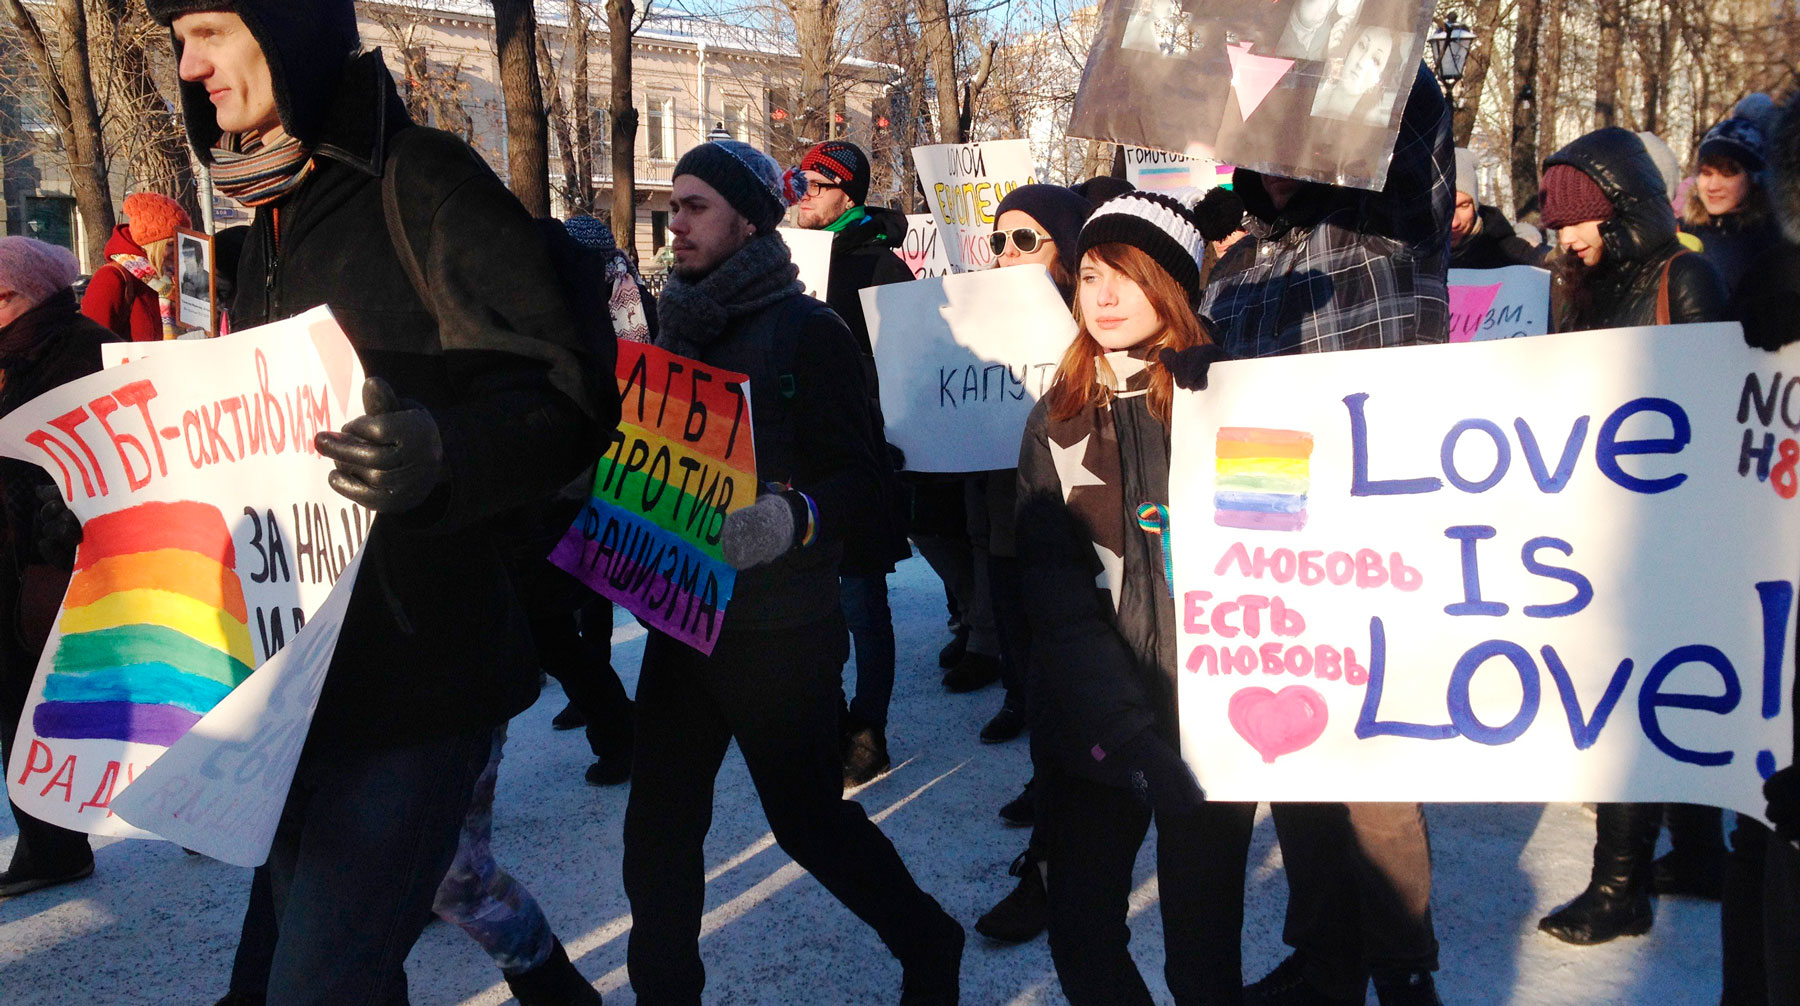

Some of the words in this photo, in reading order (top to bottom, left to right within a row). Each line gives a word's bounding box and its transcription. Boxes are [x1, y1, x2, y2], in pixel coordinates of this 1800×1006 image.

[618, 351, 744, 460] ЛГБТ
[940, 362, 1058, 409] КАПУТ
[1342, 391, 1692, 497] Love
[243, 505, 291, 584] ЗА
[1213, 541, 1424, 593] ЛЮБОВЬ
[1443, 524, 1595, 619] Is
[1185, 641, 1370, 687] ЛЮБОВЬ
